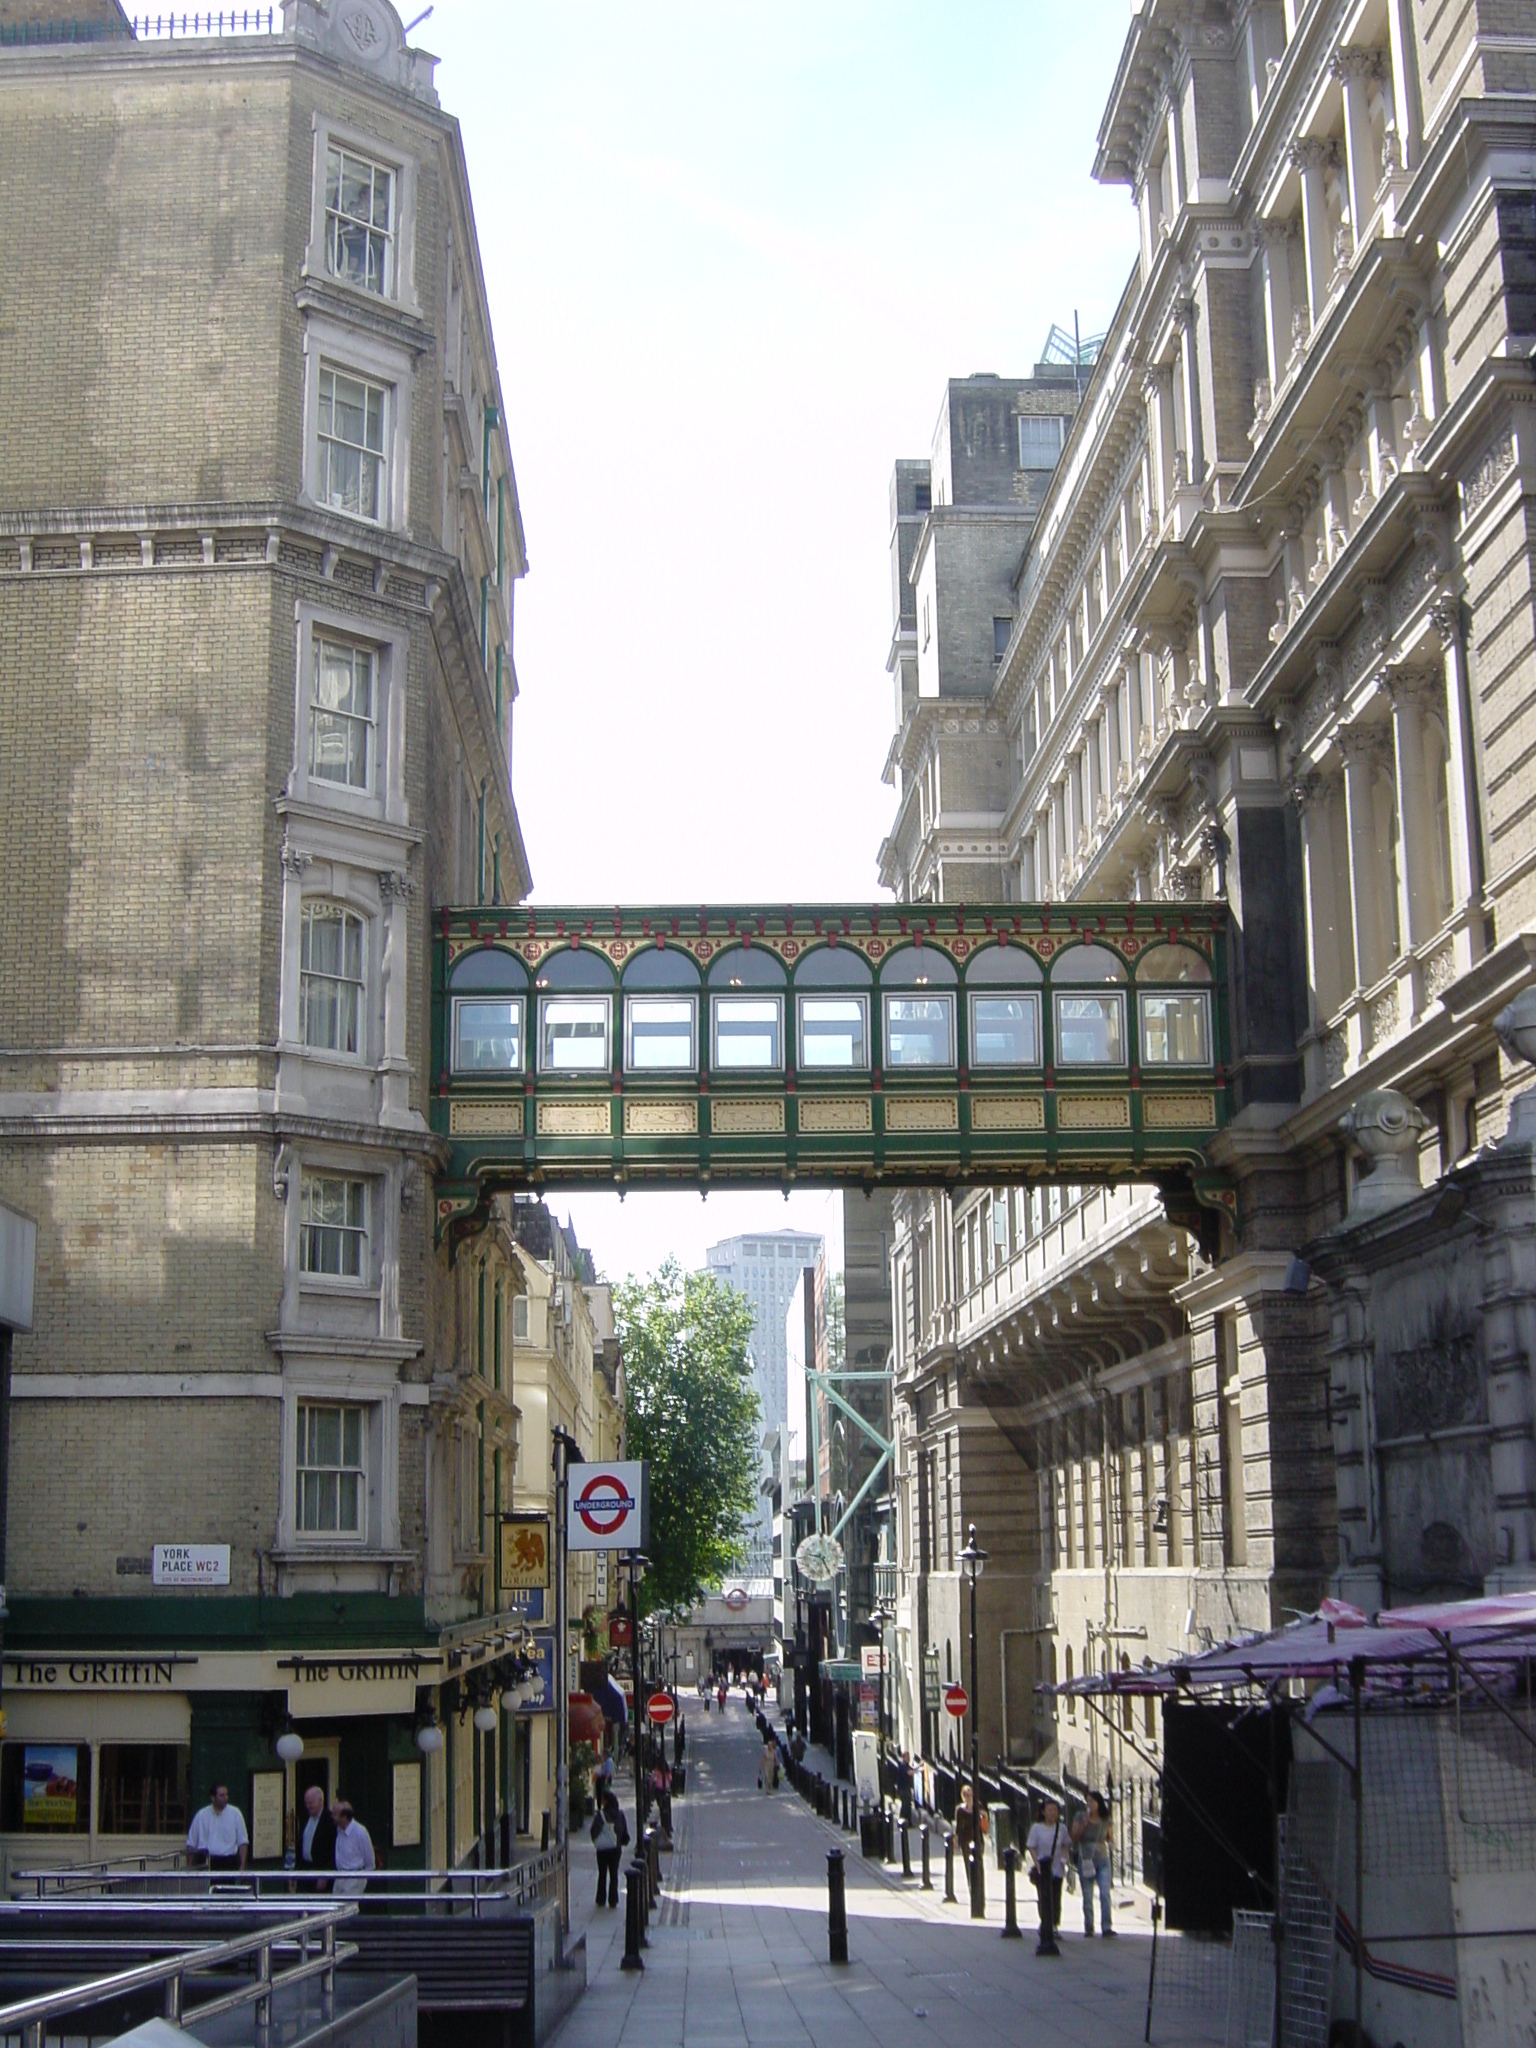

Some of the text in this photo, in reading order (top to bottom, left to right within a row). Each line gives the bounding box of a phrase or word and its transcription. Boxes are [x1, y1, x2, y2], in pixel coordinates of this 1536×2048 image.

[575, 1500, 633, 1510] UNDERGROUND
[163, 1548, 190, 1559] YORK
[162, 1561, 219, 1572] PLACE WC2
[15, 1662, 57, 1683] The
